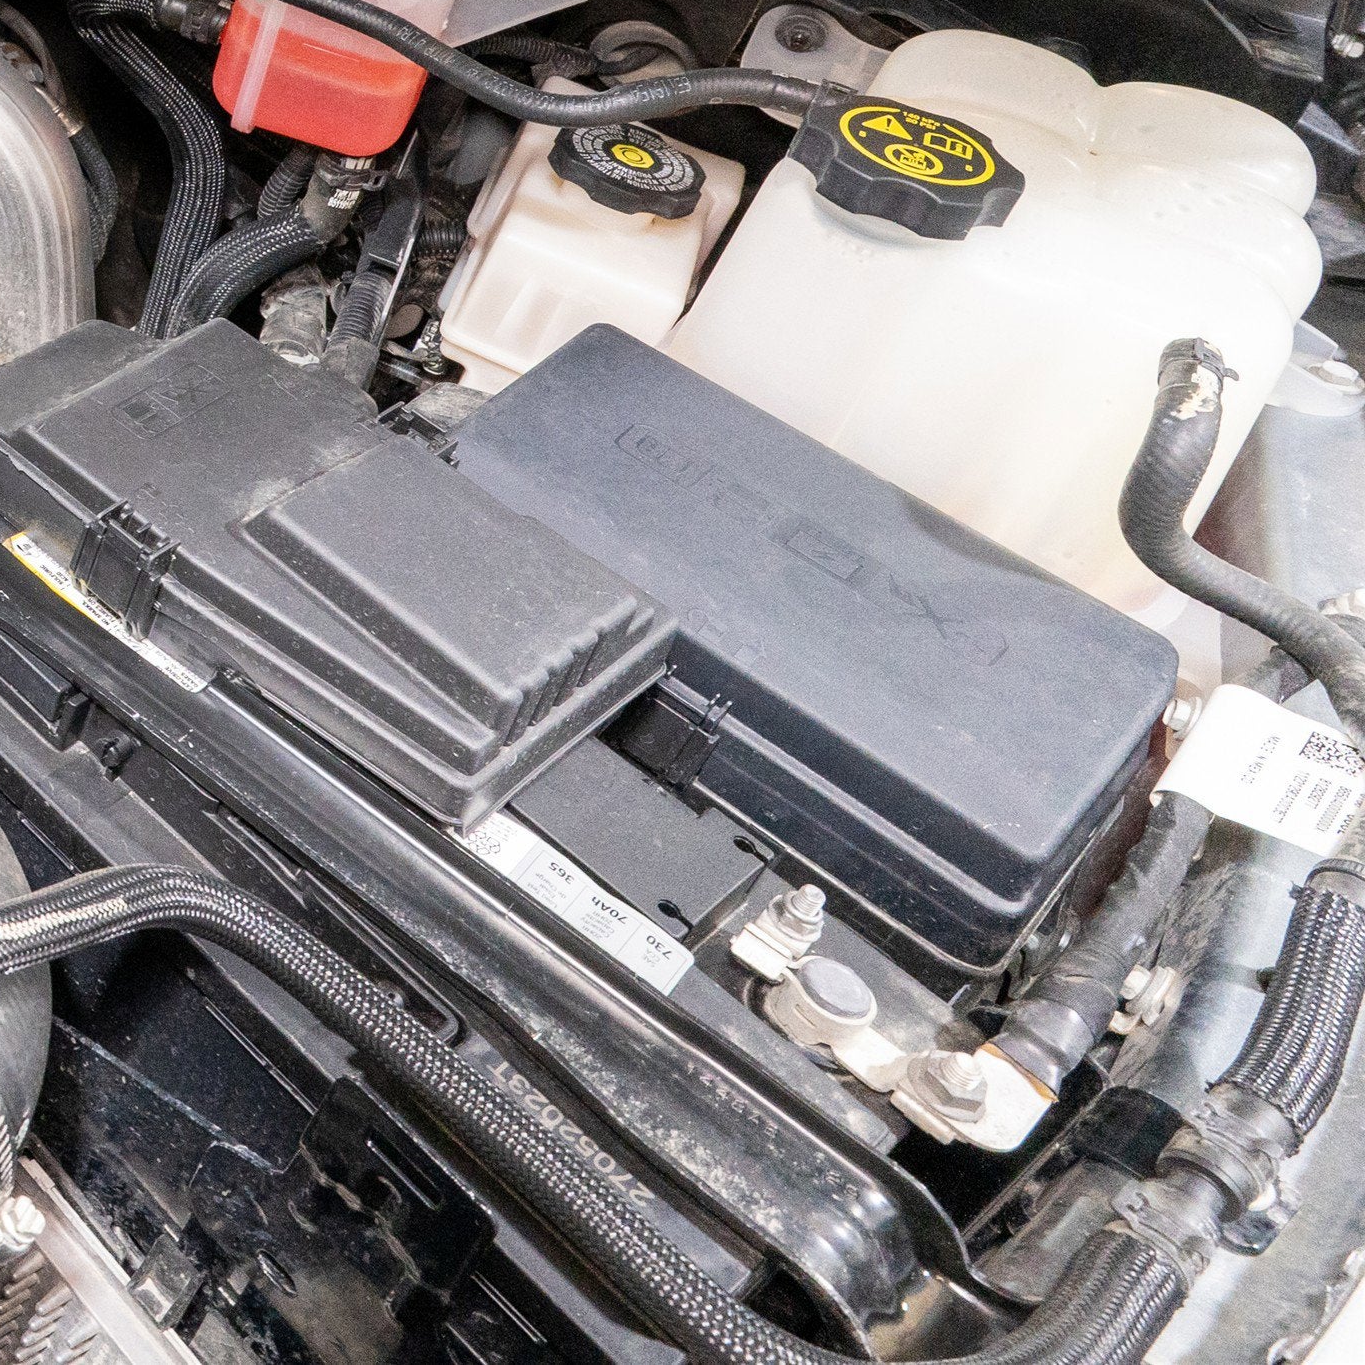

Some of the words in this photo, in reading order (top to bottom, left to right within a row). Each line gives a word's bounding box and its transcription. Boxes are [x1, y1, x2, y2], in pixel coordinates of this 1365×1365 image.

[902, 111, 920, 121] 140
[918, 121, 937, 131] PSI
[547, 861, 576, 884] 365
[590, 896, 629, 924] 70Ah
[645, 934, 674, 959] 730
